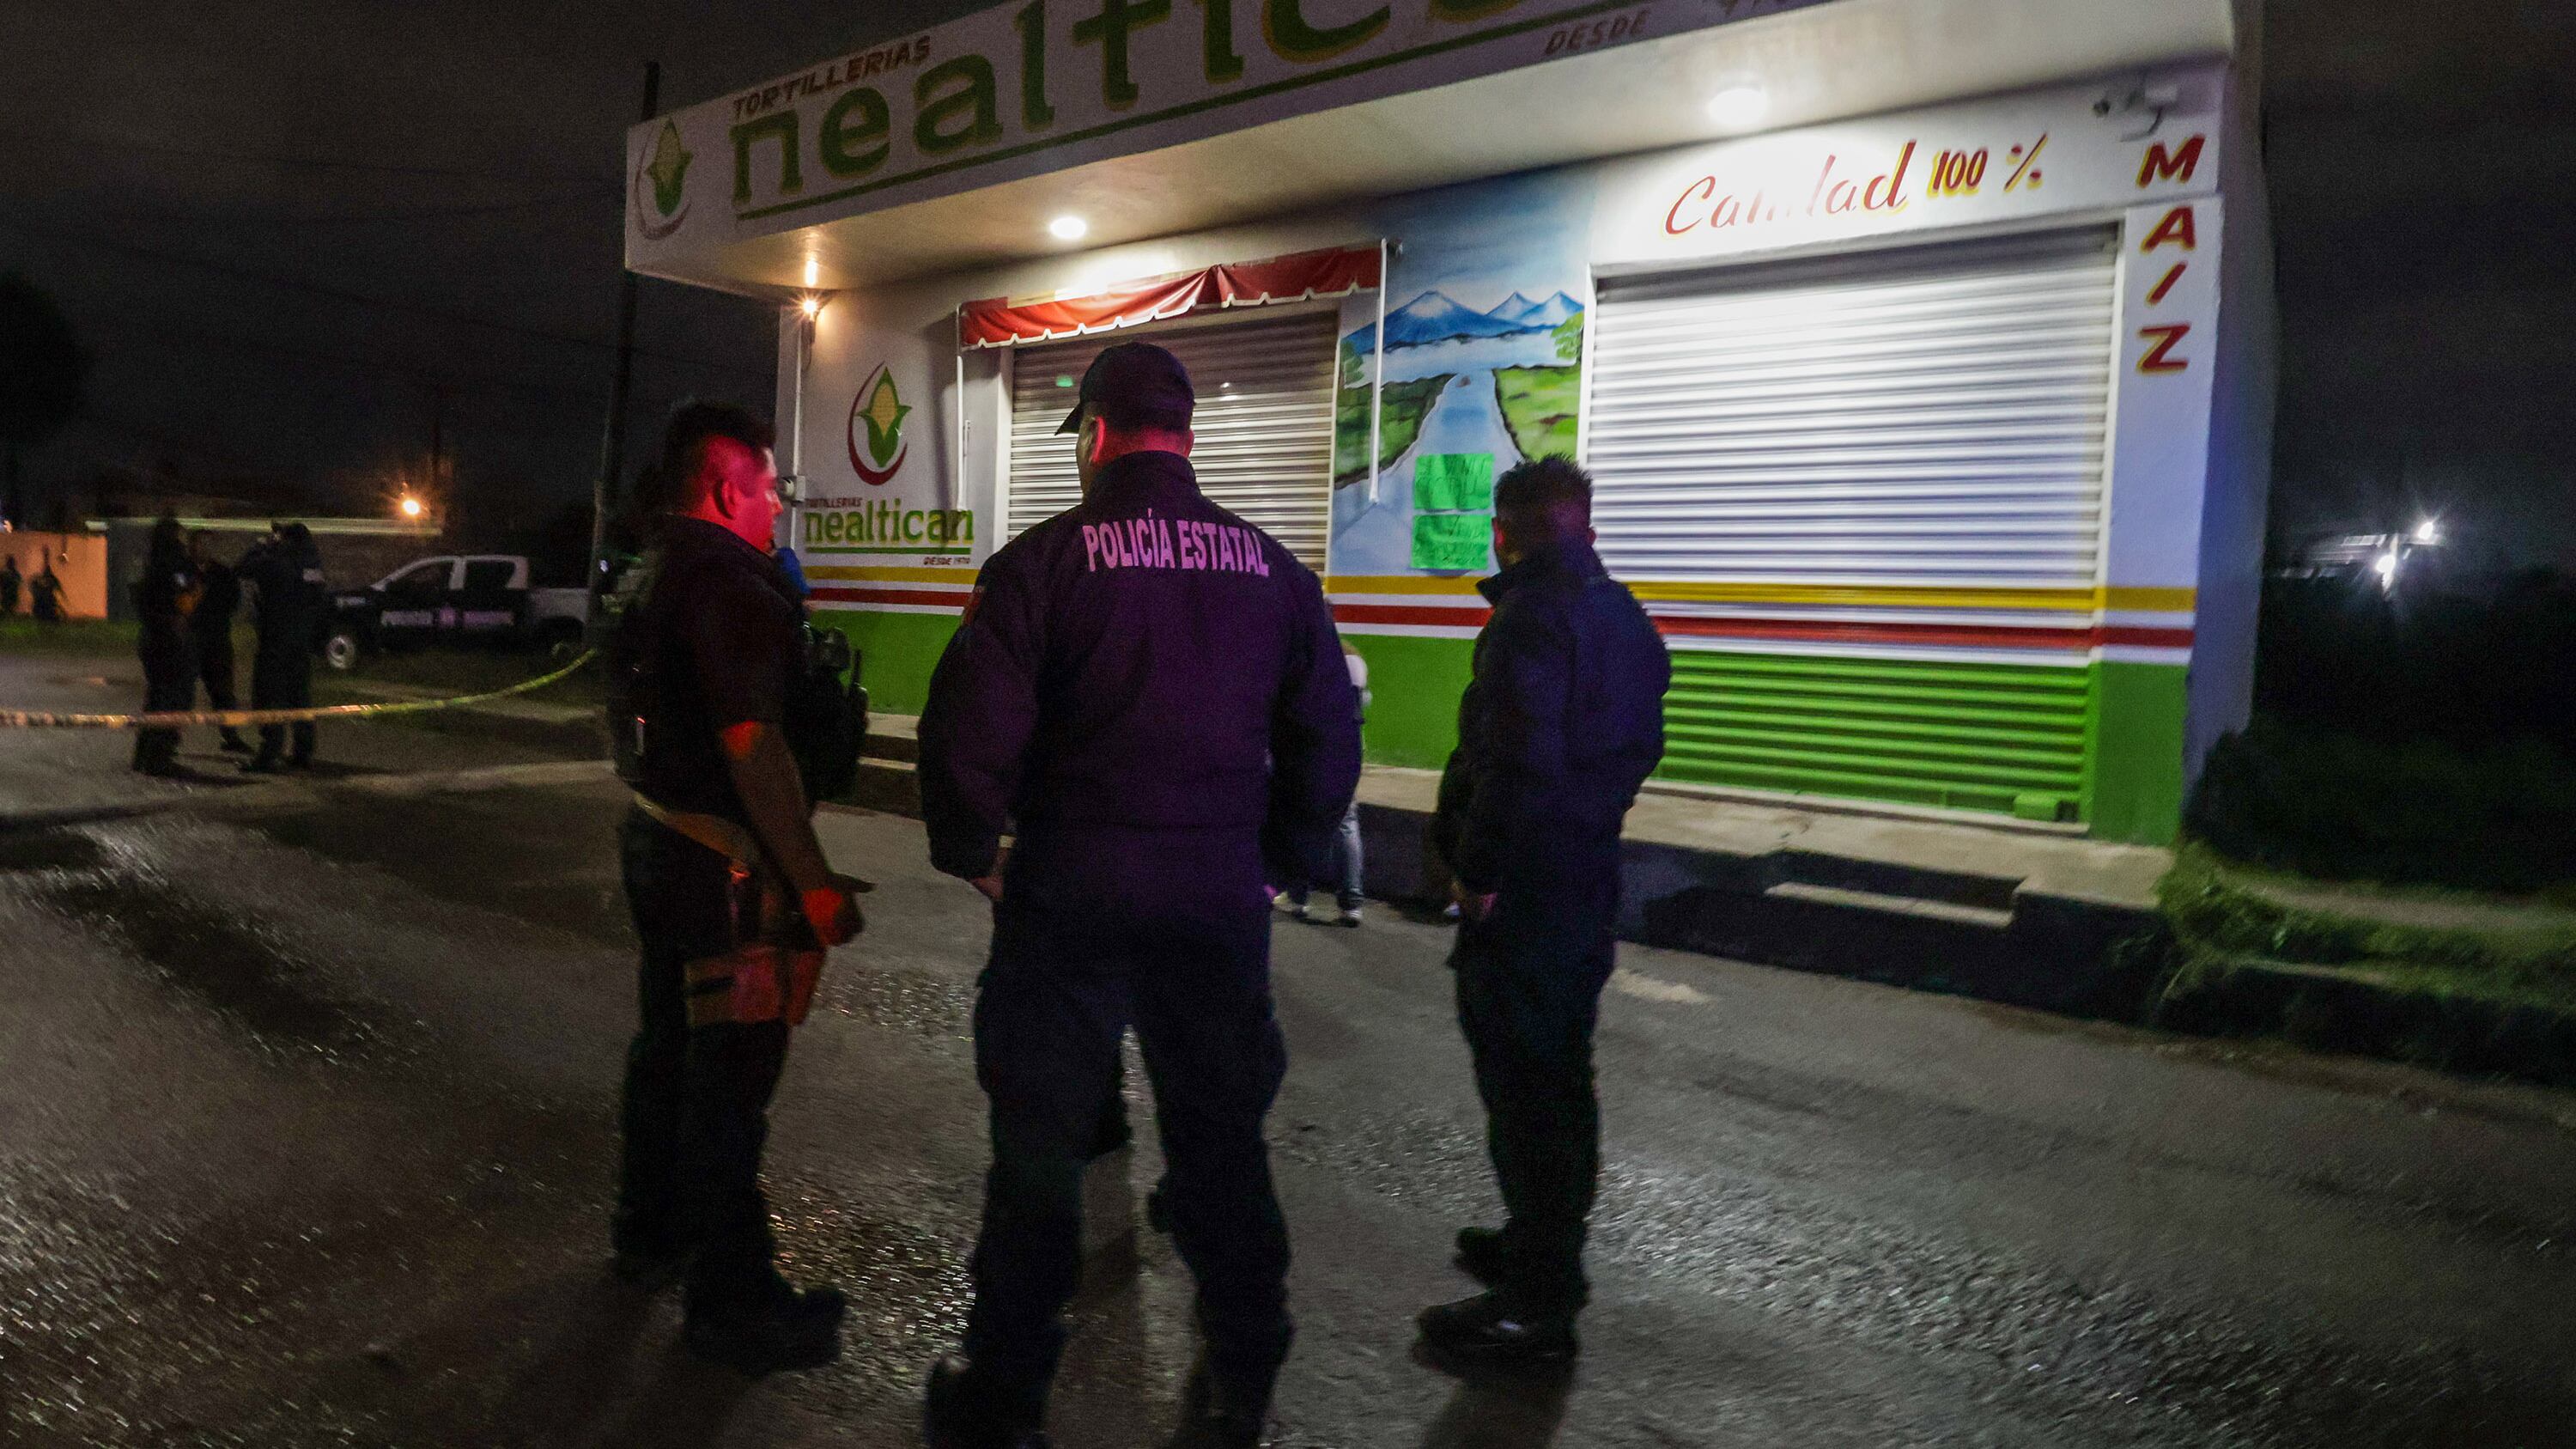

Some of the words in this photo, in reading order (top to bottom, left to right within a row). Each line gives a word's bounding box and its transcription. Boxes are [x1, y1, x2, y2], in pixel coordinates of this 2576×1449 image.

[1545, 8, 1650, 56] DESDE
[726, 0, 1520, 207] nealtic
[732, 34, 931, 119] TORTILLERIAS
[1928, 149, 1989, 198] 100
[2136, 132, 2206, 376] MAIZ
[803, 498, 975, 545] nealtican
[1082, 508, 1176, 572] POLICÍA
[1176, 520, 1269, 576] ESTATAL
